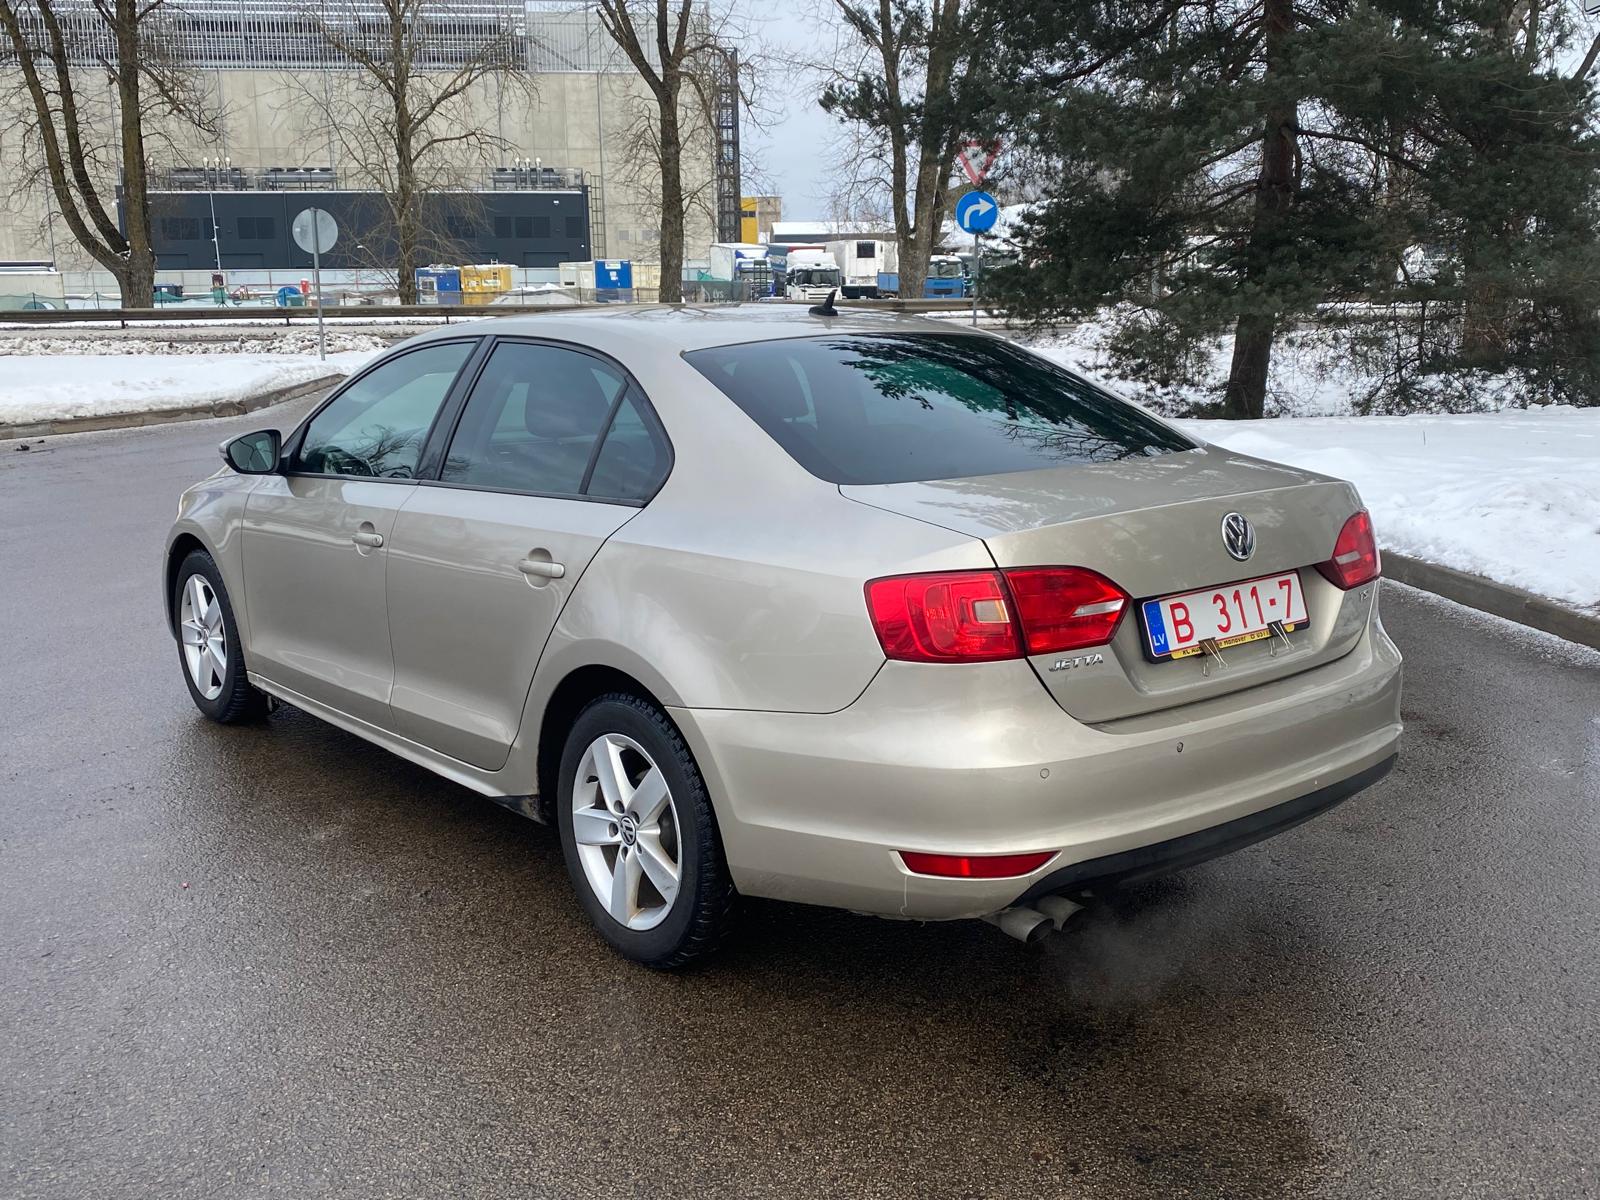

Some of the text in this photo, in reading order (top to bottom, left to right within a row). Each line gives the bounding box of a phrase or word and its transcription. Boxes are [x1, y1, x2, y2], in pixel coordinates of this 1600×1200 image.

[1169, 602, 1194, 643] B
[1152, 633, 1165, 646] LV
[1049, 654, 1103, 672] JETTA
